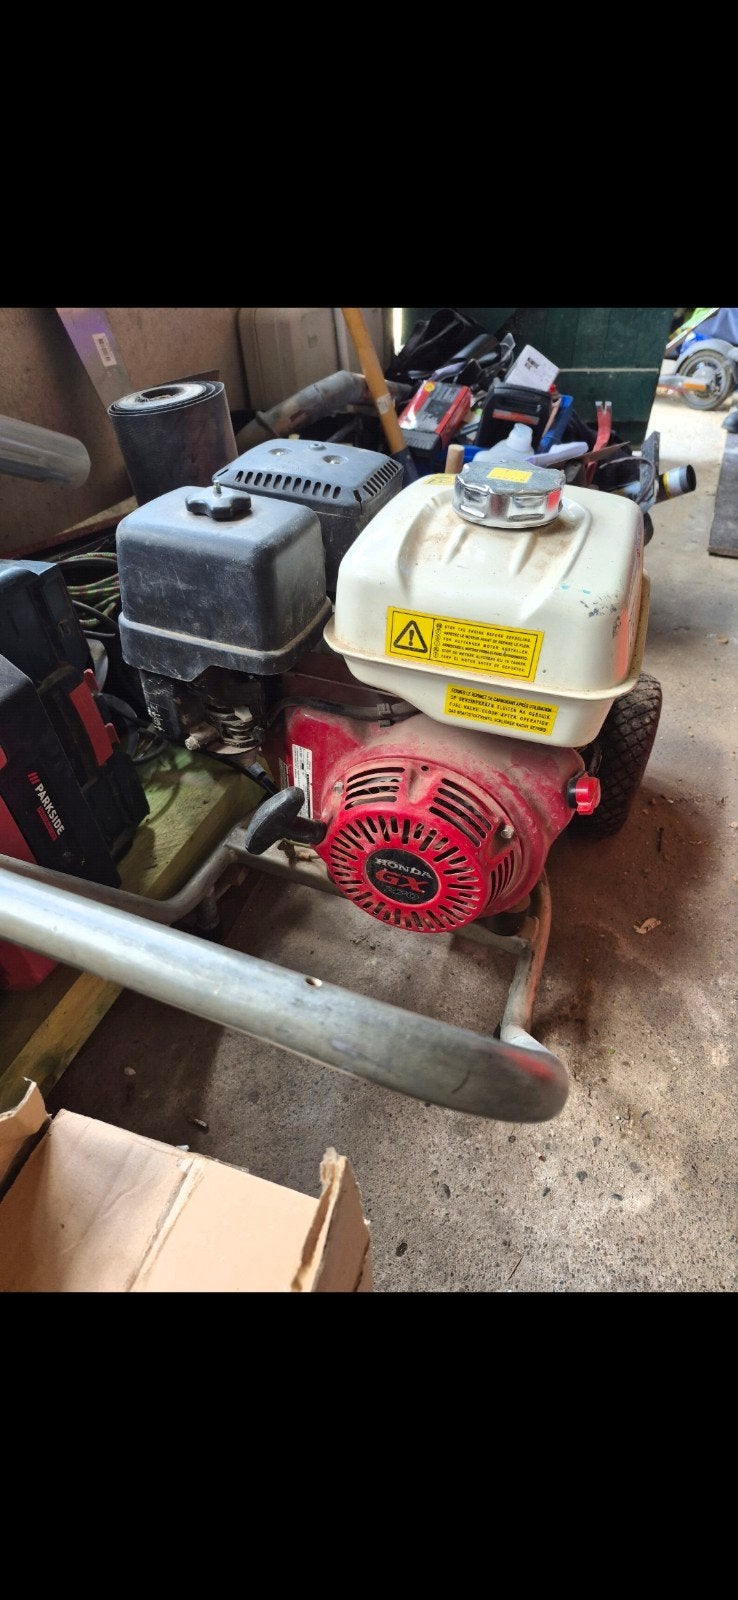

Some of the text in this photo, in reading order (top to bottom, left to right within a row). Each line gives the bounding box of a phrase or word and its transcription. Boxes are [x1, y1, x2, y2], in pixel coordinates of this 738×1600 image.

[35, 782, 65, 836] PARKSIDE
[374, 857, 433, 880] HONDA
[375, 868, 429, 893] GX
